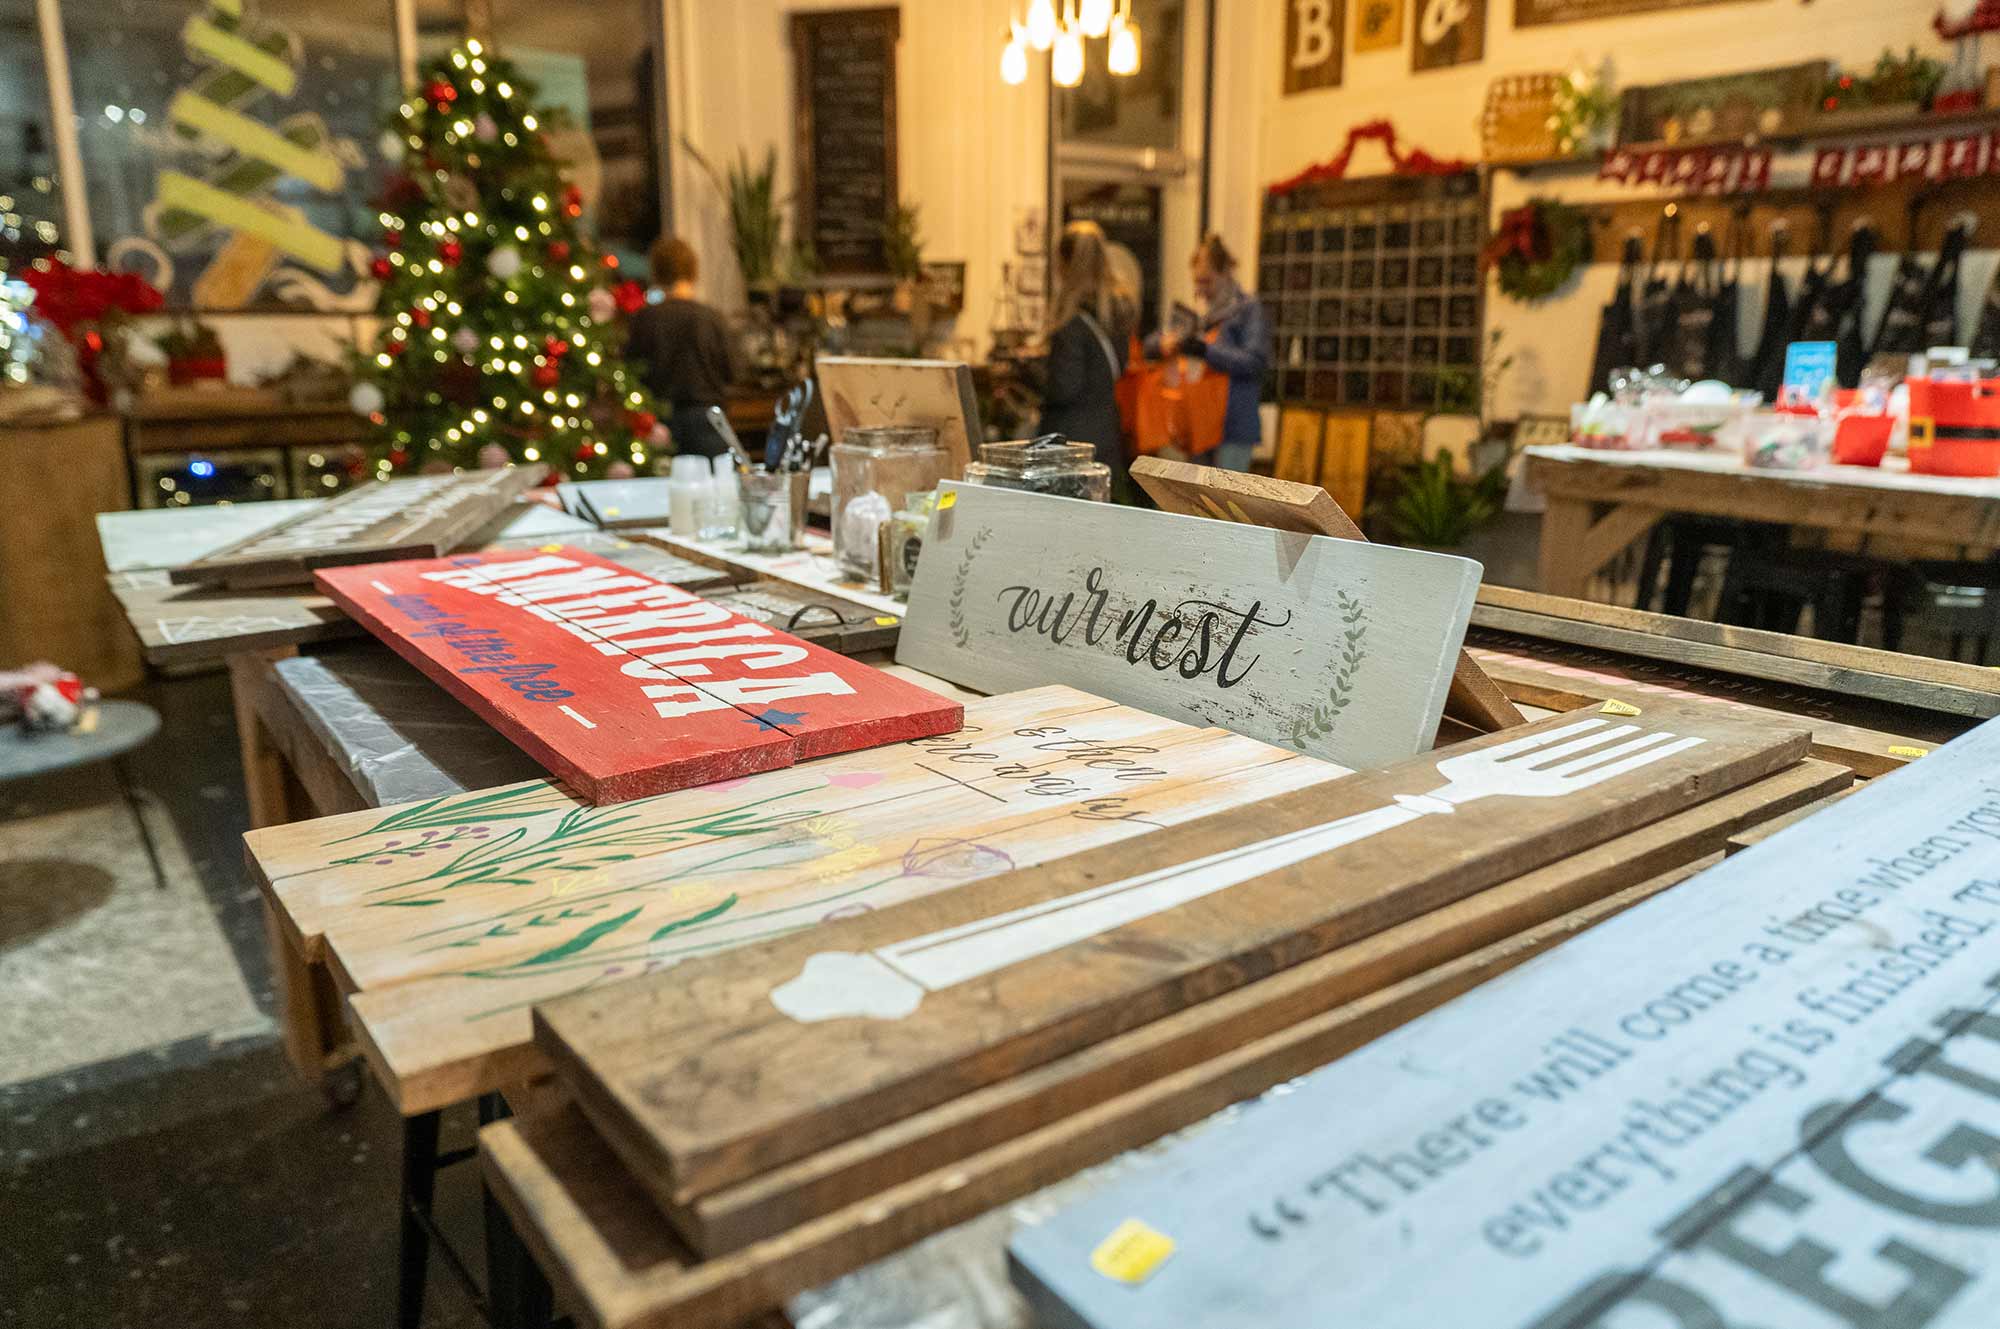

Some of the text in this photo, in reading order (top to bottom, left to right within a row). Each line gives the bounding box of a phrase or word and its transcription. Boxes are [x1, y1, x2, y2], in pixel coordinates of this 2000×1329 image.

[410, 622, 499, 638] of
[419, 555, 857, 718] AMERICA
[447, 638, 517, 664] the
[997, 567, 1291, 688] our nest
[458, 663, 575, 702] free
[906, 726, 1000, 763] ere
[992, 763, 1091, 798] was
[1033, 737, 1167, 781] then
[1856, 834, 1972, 889] when
[1761, 886, 1881, 945] time
[1743, 941, 1795, 966] a
[1619, 959, 1759, 1042] come
[1513, 1027, 1634, 1102] will
[1482, 1048, 1807, 1257] everything
[1753, 1018, 1836, 1056] is
